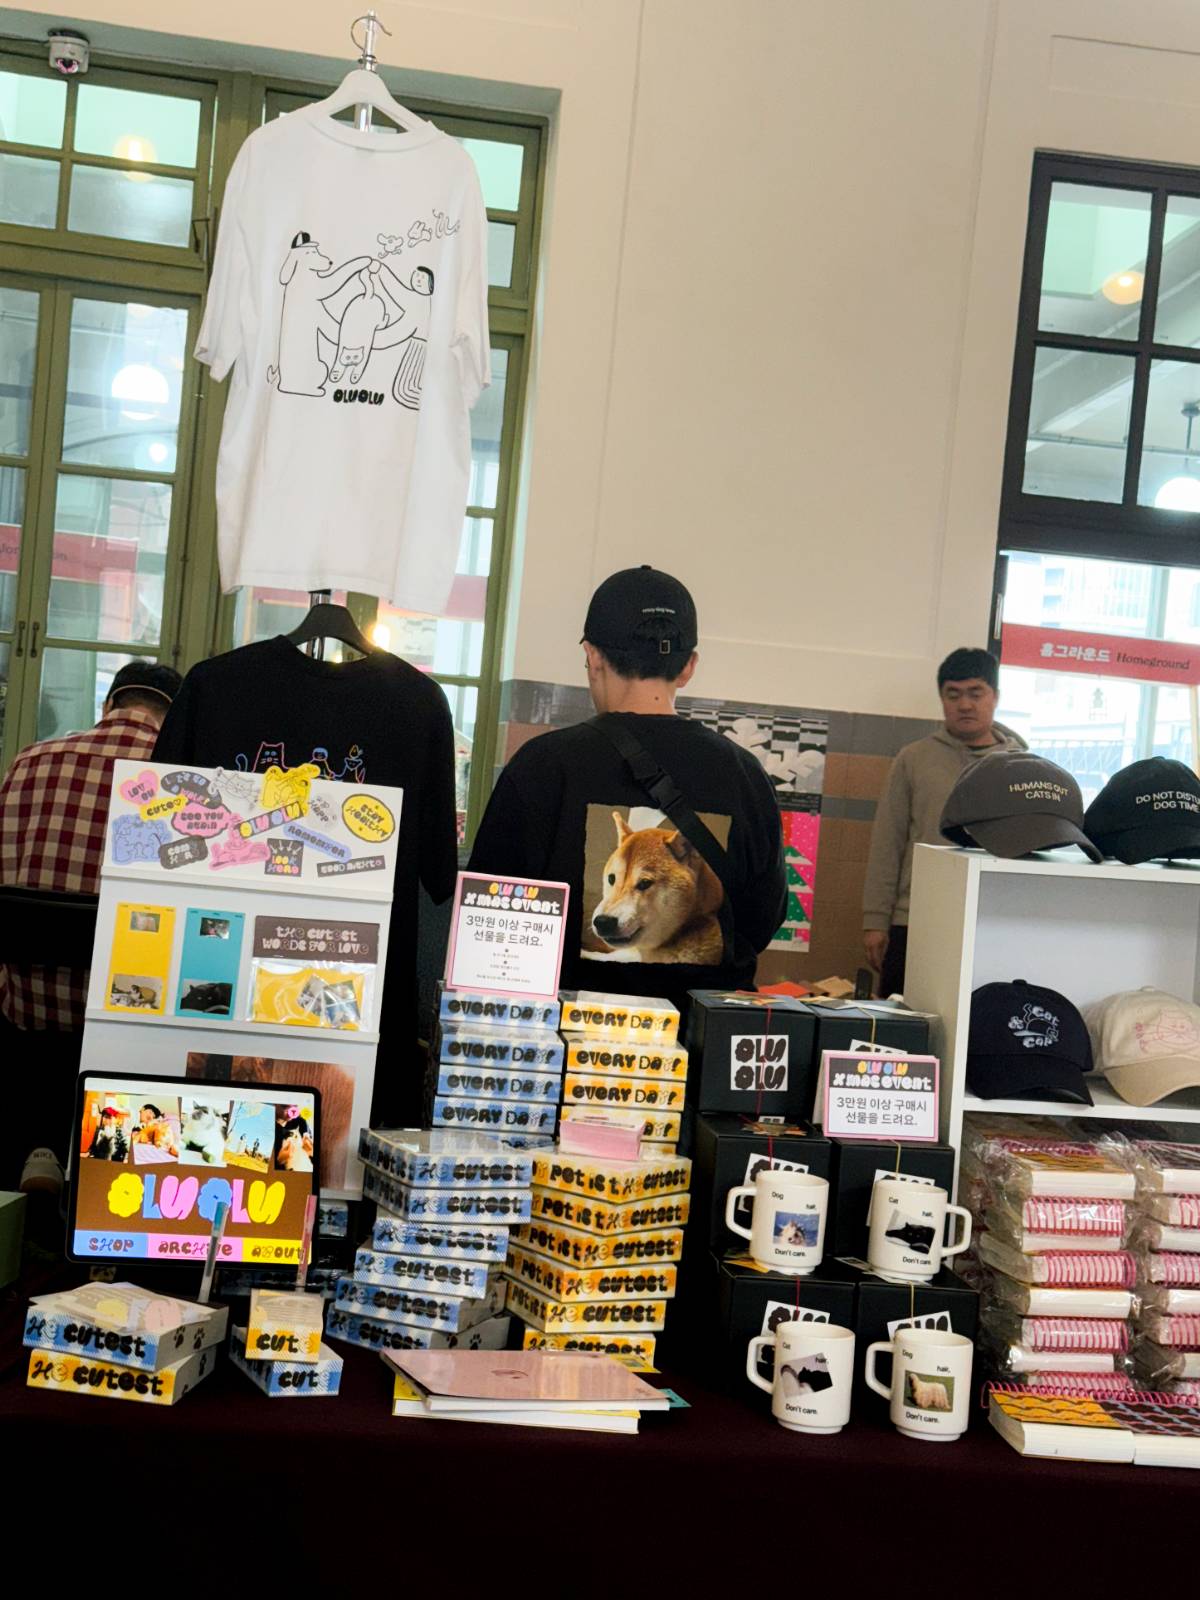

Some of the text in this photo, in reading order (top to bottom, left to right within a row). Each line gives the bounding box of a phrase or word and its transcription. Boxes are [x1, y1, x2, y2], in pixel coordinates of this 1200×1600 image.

[1117, 652, 1190, 670] Homeground
[1009, 781, 1068, 796] HUMANS OUT
[1025, 790, 1061, 802] CATS IN
[1135, 794, 1151, 804] DO
[1152, 791, 1174, 801] NOT
[1153, 801, 1200, 813] DOG TIME
[466, 915, 554, 935] 3만원 이상 구매시
[474, 929, 543, 947] 선물을 드려요.
[735, 1038, 787, 1063] OLU
[734, 1065, 787, 1090] OLU
[837, 1097, 927, 1112] 3만원 이상 구매시
[846, 1111, 918, 1126] 선물을 드려요.
[107, 1172, 286, 1225] OLUOLU
[906, 1411, 922, 1421] Don't
